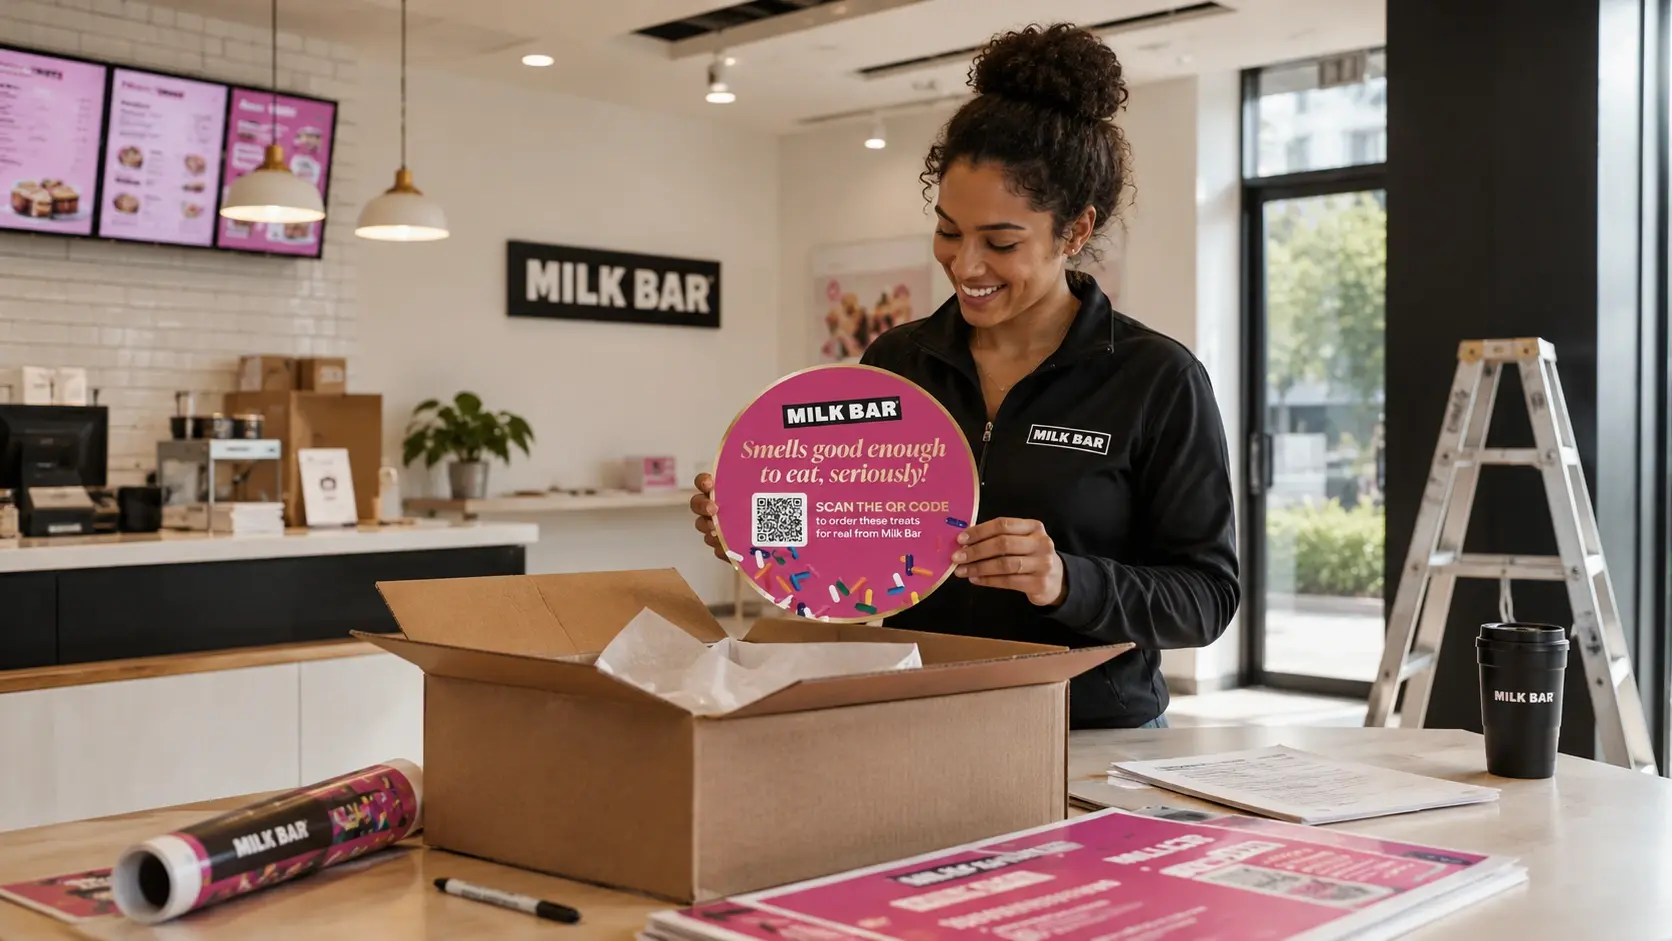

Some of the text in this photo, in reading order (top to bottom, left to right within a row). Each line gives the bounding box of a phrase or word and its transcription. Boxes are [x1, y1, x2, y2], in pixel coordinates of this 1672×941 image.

[526, 258, 711, 314] MILK BAR
[787, 400, 898, 424] MILK BAR
[1033, 429, 1104, 448] MILK BAR
[741, 438, 946, 464] Smells good enough
[760, 464, 929, 488] to eat, seriously!
[816, 501, 949, 513] SCAN THE QR CODE
[816, 516, 920, 526] to order these treats
[816, 528, 922, 539] for real from Milk Bar
[1494, 690, 1554, 703] MILK BAR
[232, 819, 309, 858] MILK BAR
